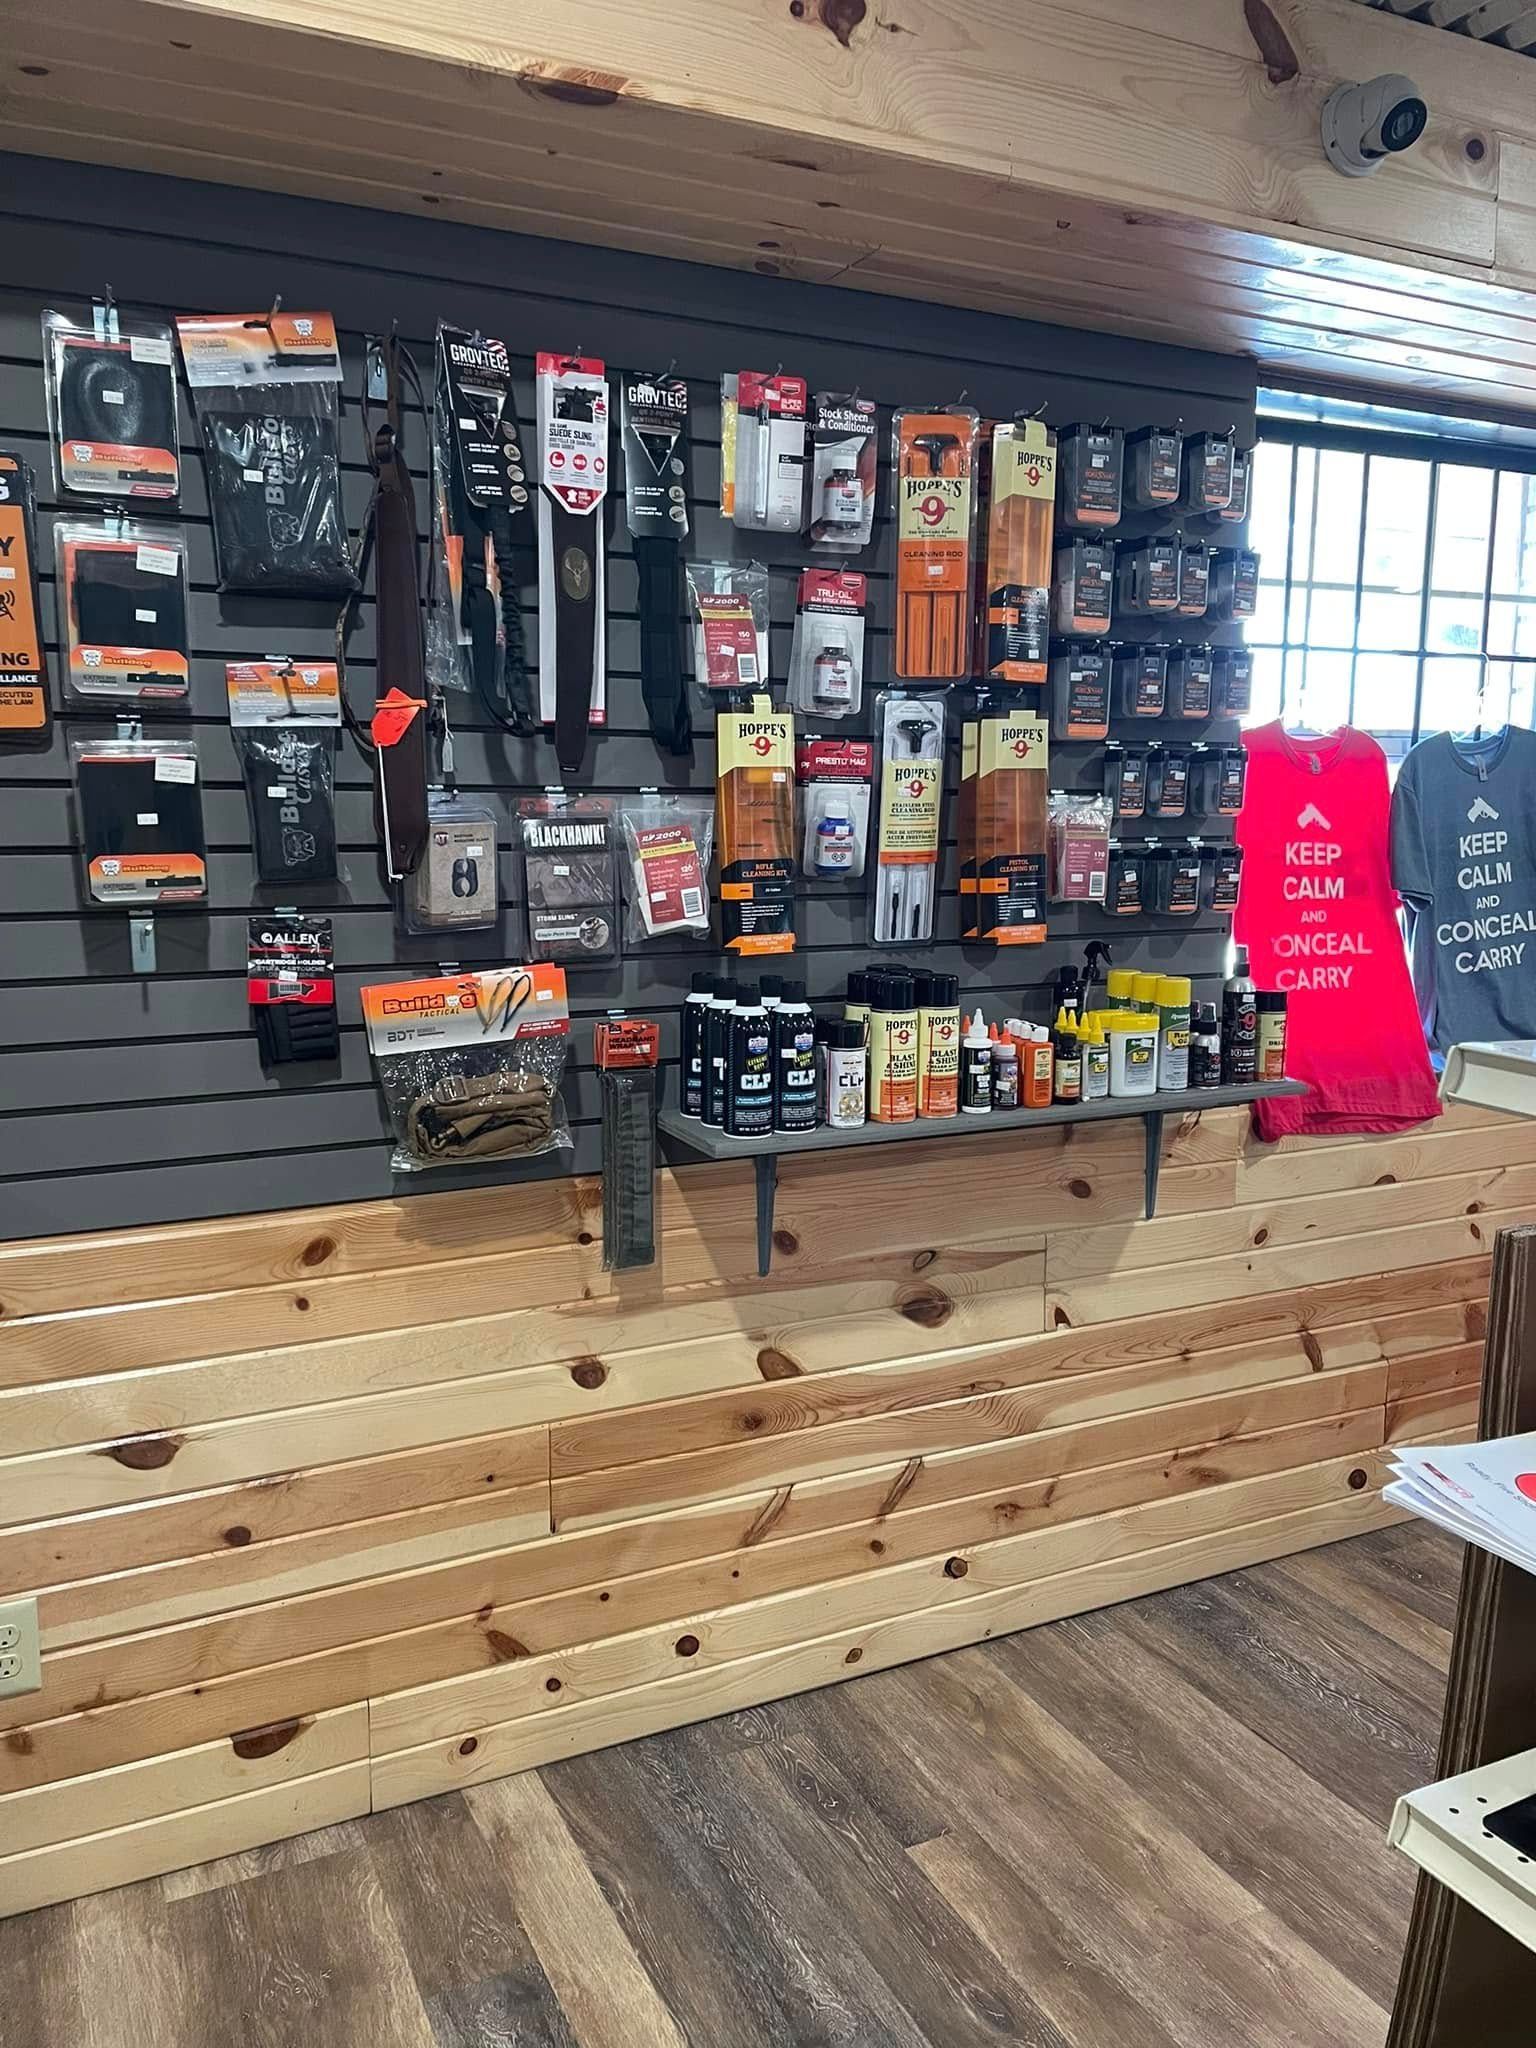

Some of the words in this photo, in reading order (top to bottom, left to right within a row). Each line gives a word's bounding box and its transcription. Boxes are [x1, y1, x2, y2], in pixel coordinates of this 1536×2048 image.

[450, 344, 505, 371] GROVTEC
[628, 386, 682, 409] GROVTEC
[819, 407, 842, 419] Stock
[844, 409, 869, 422] Sheen
[549, 428, 573, 440] SUEDE
[574, 430, 593, 441] SLING
[819, 419, 826, 429] &
[828, 420, 874, 434] Conditioner
[1017, 451, 1053, 472] HOPPE'S
[1028, 466, 1040, 487] 9
[907, 480, 962, 499] HOPPE'S
[920, 496, 947, 526] 9
[817, 588, 852, 600] TRU-OIL
[739, 723, 786, 739] HOPPE'S
[1002, 728, 1043, 743] HOPPE'S
[754, 736, 772, 757] 9
[1015, 740, 1029, 759] 9
[895, 768, 937, 782] HOPPE'S
[910, 780, 924, 798] 9
[531, 824, 606, 847] BLACKHAWK!
[1459, 831, 1508, 858] KEEP
[1285, 841, 1342, 866] KEEP
[742, 870, 776, 878] CLEANING
[1457, 861, 1512, 890] CALM
[1283, 876, 1344, 900] CALM
[1476, 895, 1500, 910] AND
[1301, 910, 1327, 923] AND
[1436, 910, 1536, 946] CONCEAL
[273, 932, 319, 944] ALLEN
[1270, 932, 1373, 958] ONCEAL
[1455, 943, 1526, 973] CARRY
[1275, 965, 1353, 992] CARRY
[419, 1008, 460, 1018] TACTICAL
[387, 1029, 415, 1042] BDT
[898, 1030, 911, 1045] 9
[939, 1026, 952, 1040] 9
[741, 1073, 771, 1090] CLP
[788, 1069, 815, 1086] CLP
